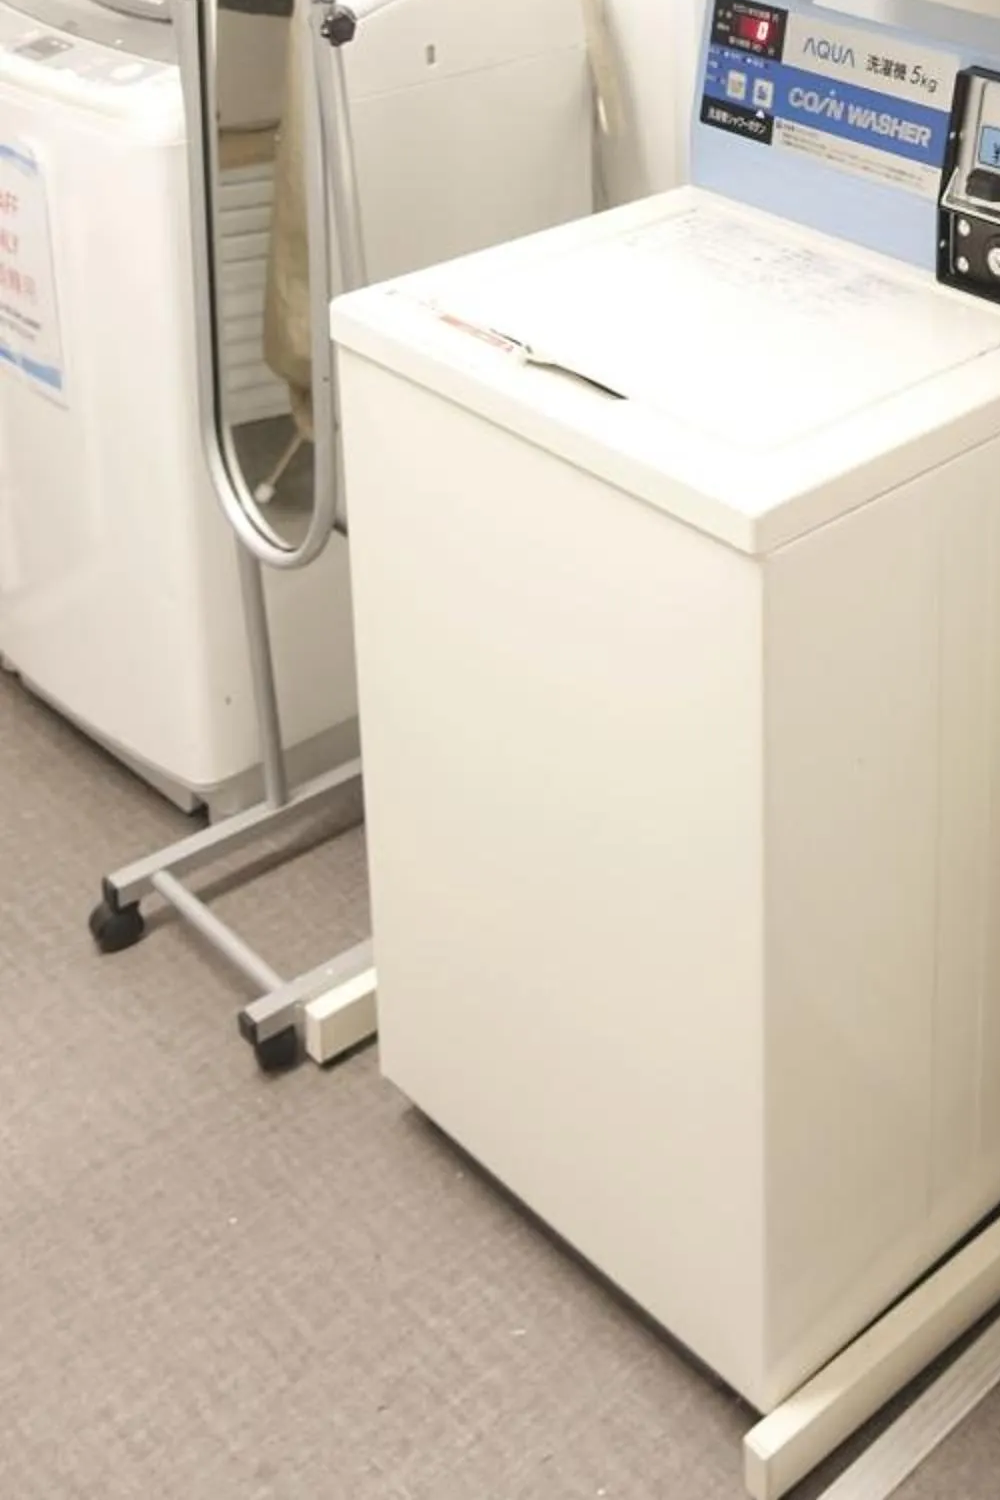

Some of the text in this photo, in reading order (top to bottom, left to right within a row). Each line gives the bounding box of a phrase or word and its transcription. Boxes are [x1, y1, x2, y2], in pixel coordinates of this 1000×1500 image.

[803, 37, 856, 69] AQUA
[865, 53, 907, 82] 洗濯機
[910, 65, 939, 93] 5kg
[847, 103, 932, 148] WASHER
